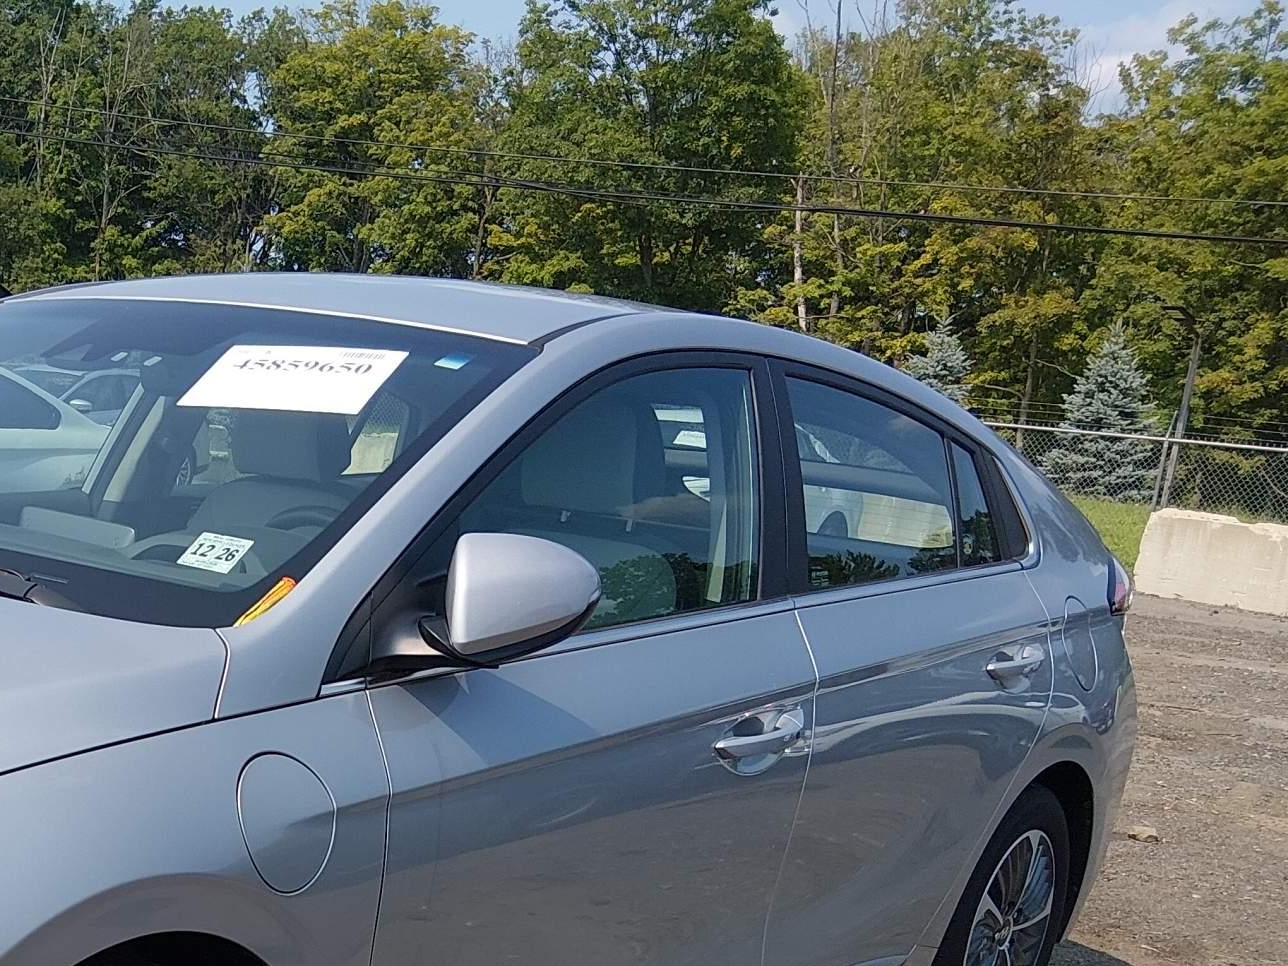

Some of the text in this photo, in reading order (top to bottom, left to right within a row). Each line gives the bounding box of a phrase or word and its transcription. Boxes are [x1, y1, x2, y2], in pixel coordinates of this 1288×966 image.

[234, 359, 373, 375] 45859650
[190, 543, 240, 561] 12 26
